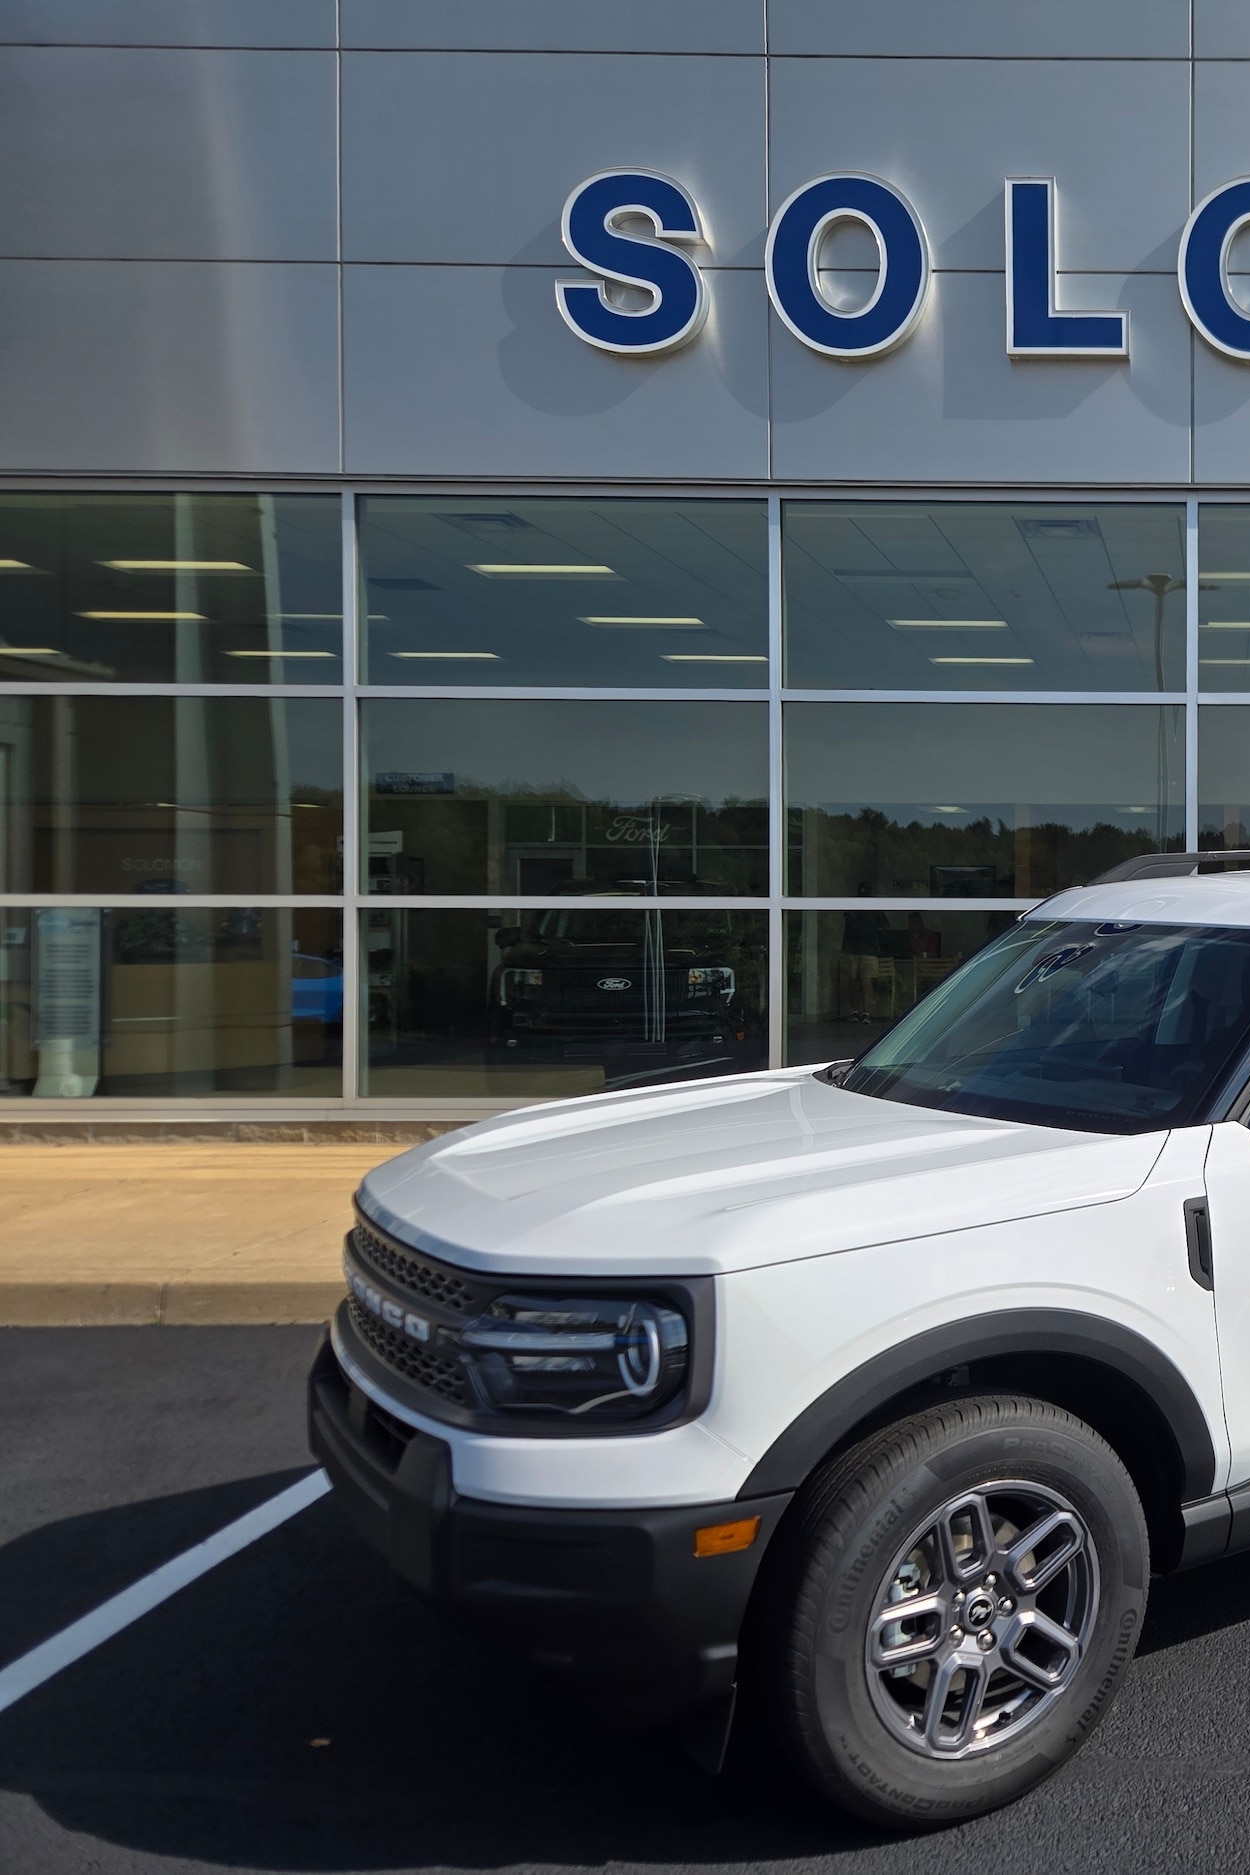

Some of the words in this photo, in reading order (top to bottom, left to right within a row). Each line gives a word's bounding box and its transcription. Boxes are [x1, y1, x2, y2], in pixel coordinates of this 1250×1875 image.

[383, 773, 445, 783] CUSTOMER
[605, 815, 671, 842] Ford
[121, 858, 203, 872] SOLOMON
[602, 979, 628, 989] Ford
[1076, 1608, 1137, 1731] Continental
